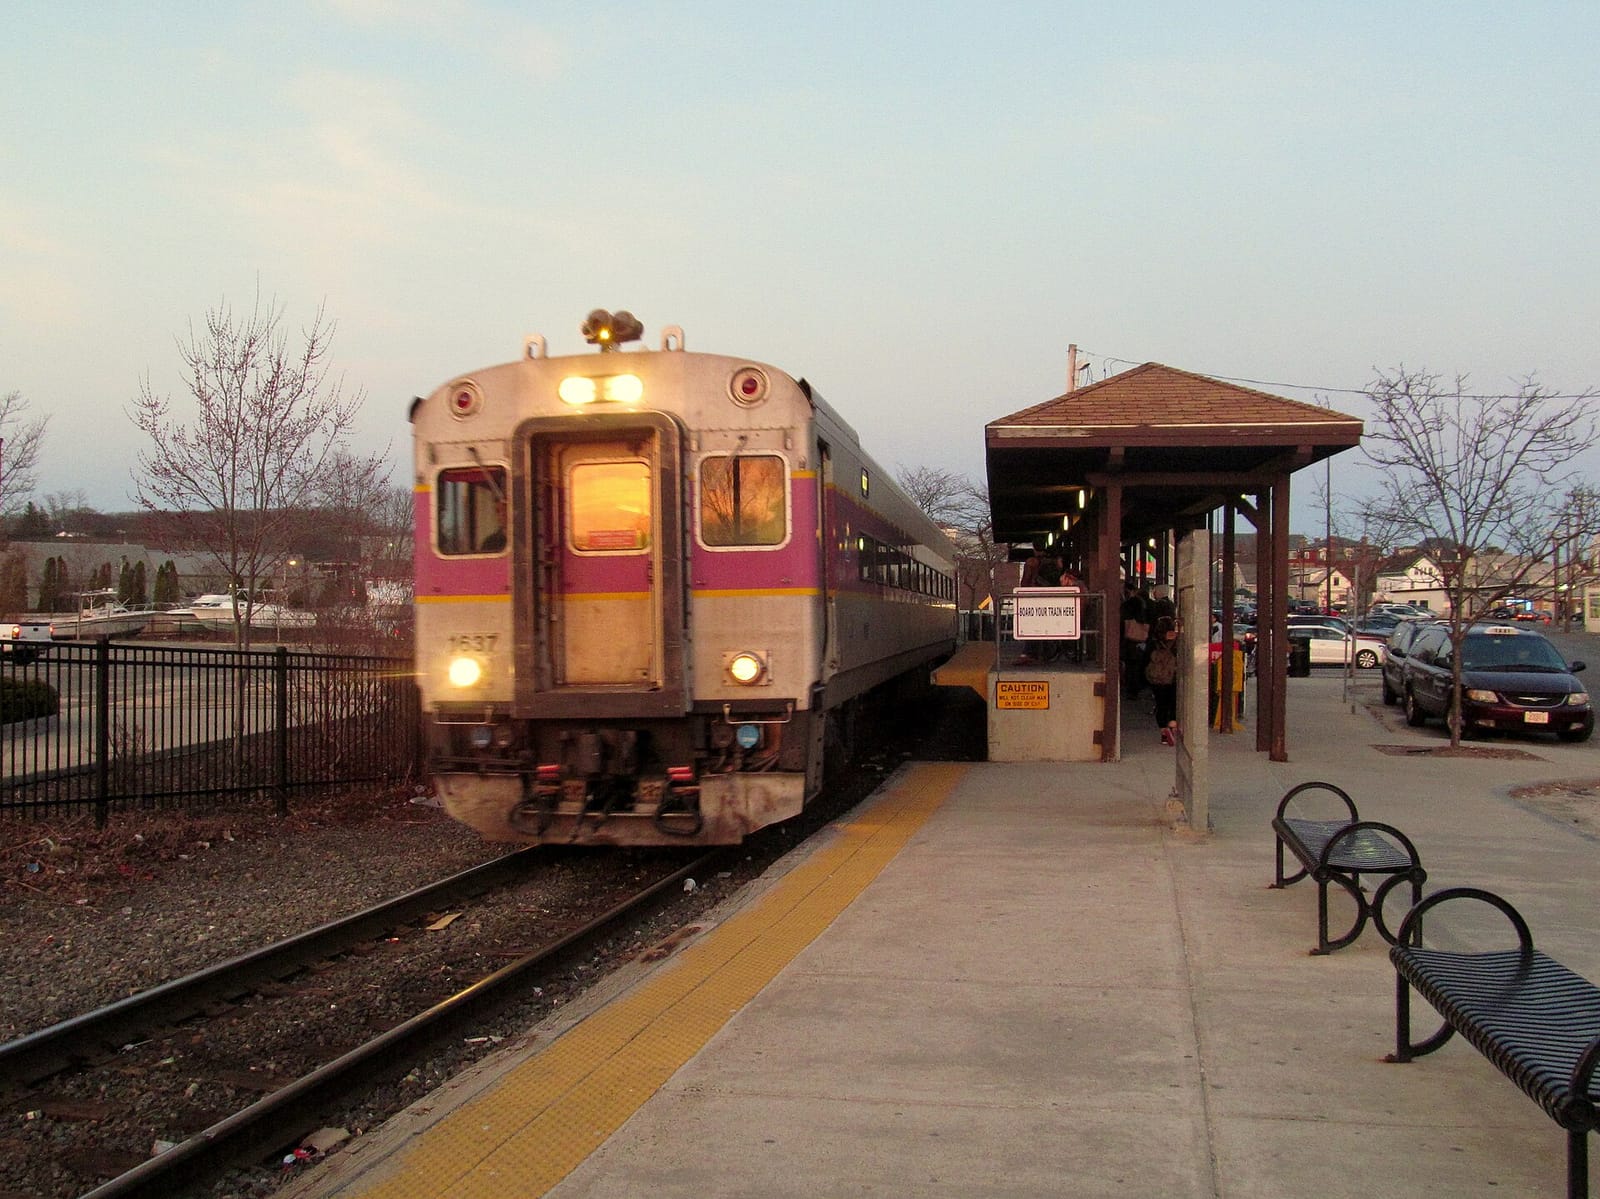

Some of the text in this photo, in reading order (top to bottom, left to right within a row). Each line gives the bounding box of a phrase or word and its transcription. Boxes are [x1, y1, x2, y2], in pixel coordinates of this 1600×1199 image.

[1020, 606, 1074, 616] BOARD YOUR TRAIN HERE
[1000, 684, 1045, 692] CAUTION
